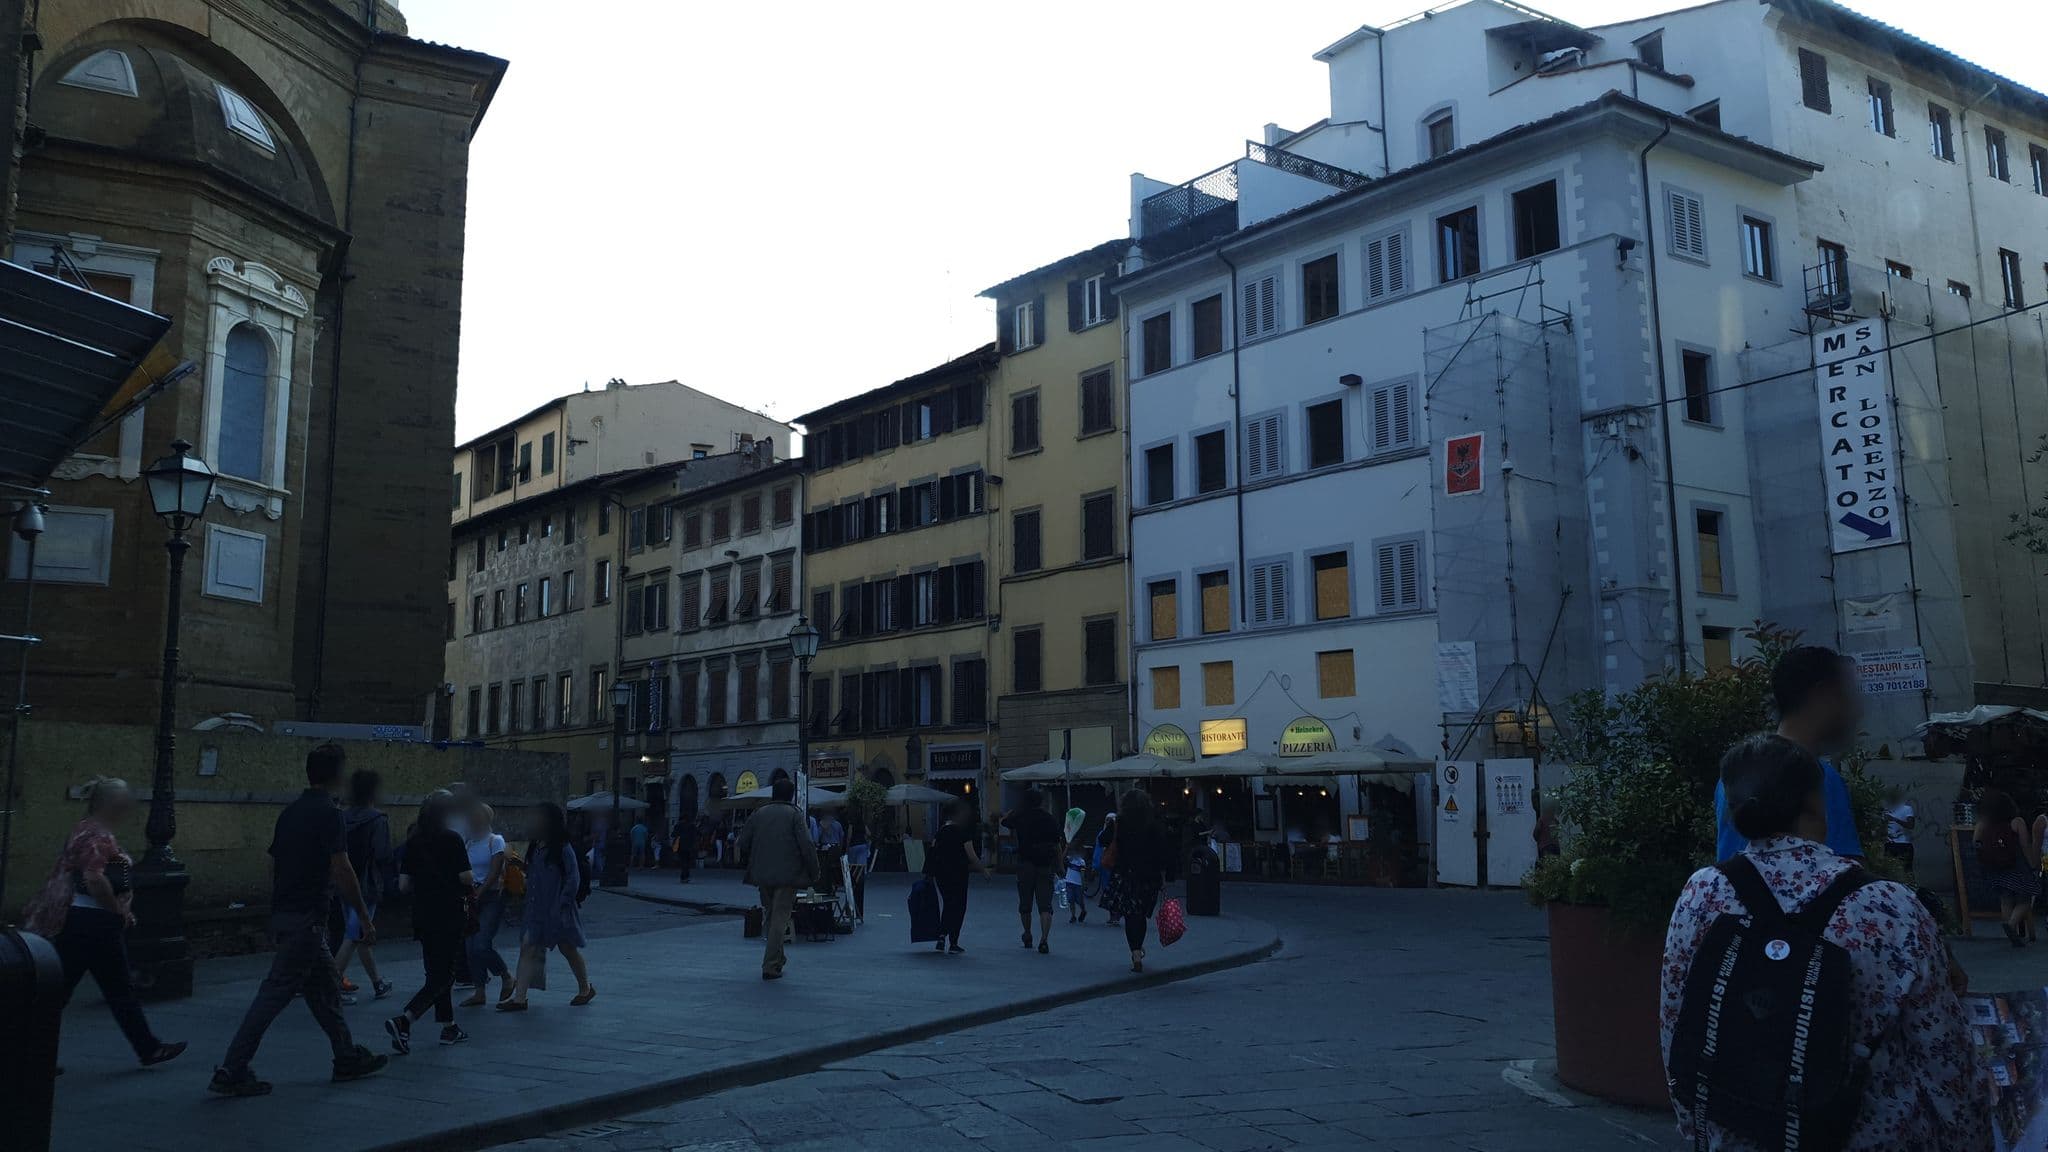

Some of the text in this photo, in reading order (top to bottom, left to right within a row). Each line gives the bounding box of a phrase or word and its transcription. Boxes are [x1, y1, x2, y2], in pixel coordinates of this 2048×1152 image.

[1856, 326, 1876, 377] SAN
[1823, 333, 1859, 508] MERCATO
[1859, 398, 1889, 519] LORENZO
[1869, 682, 1884, 692] 339
[1886, 680, 1925, 689] 7012188
[1295, 726, 1324, 734] Heineken
[1201, 732, 1245, 743] RISTORANTE
[1282, 743, 1332, 754] PIZZERIA
